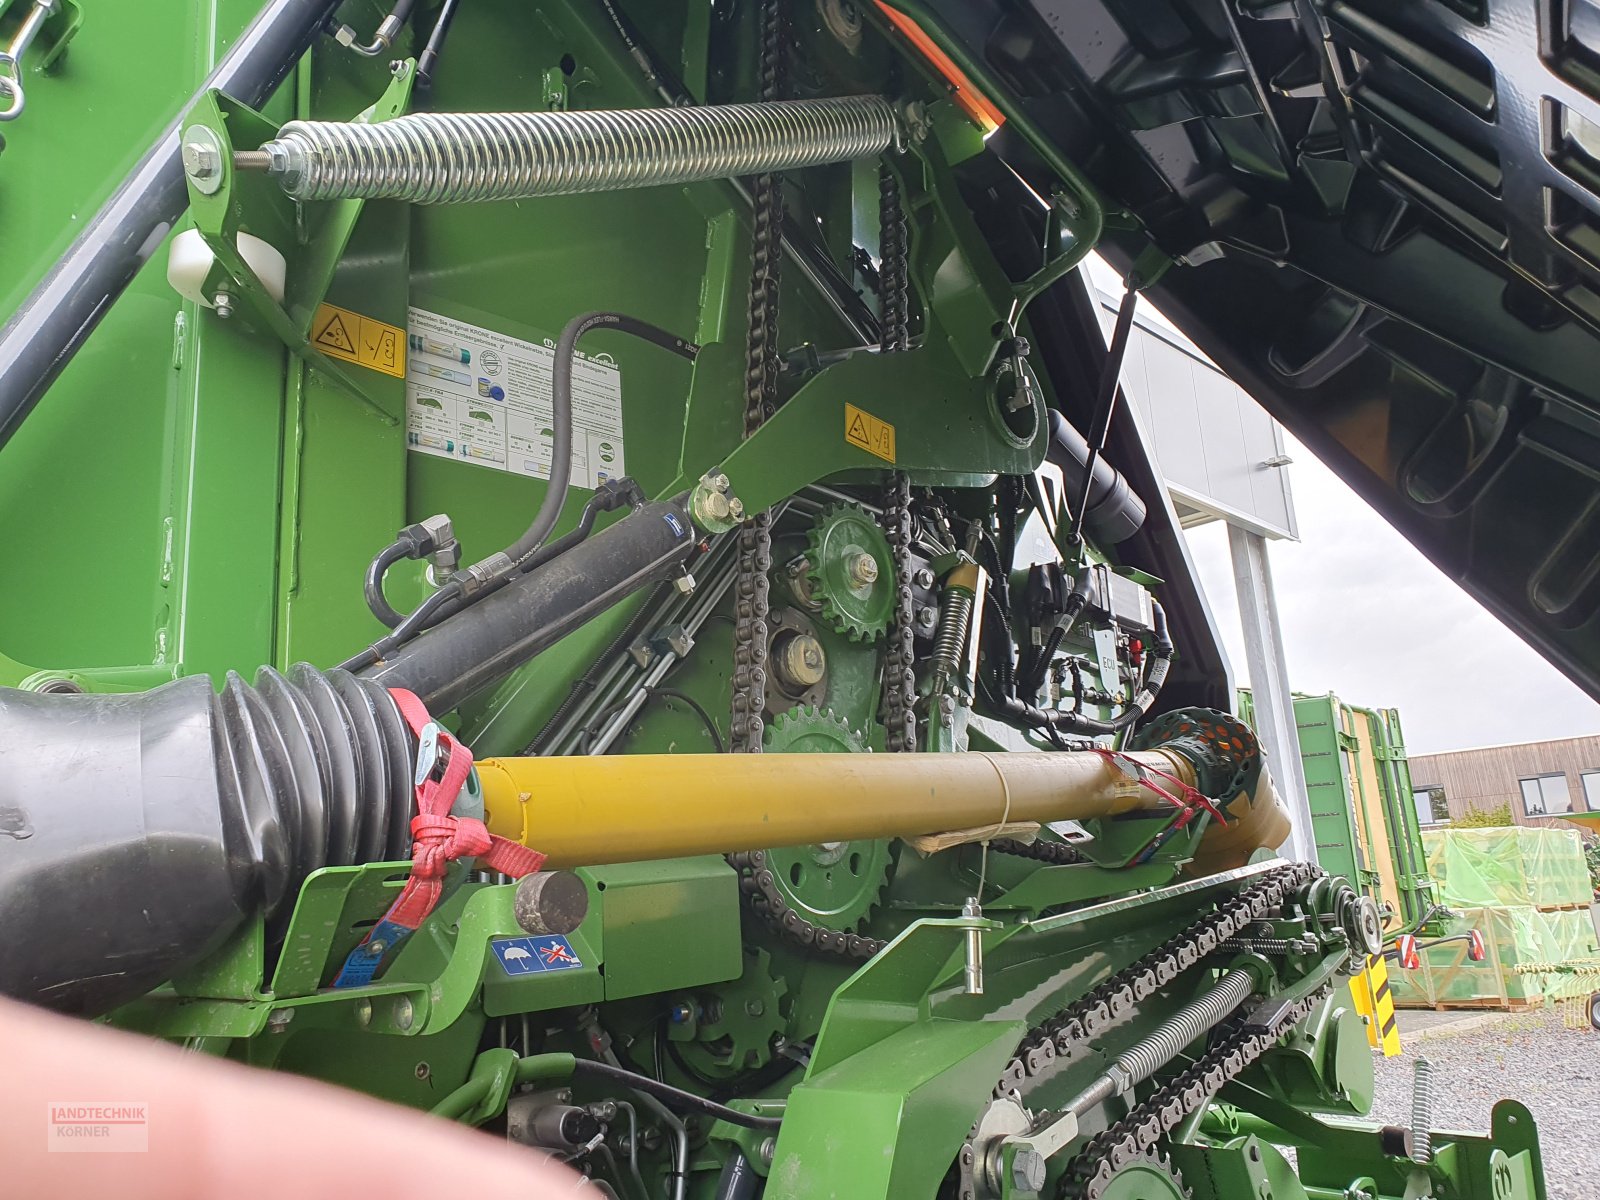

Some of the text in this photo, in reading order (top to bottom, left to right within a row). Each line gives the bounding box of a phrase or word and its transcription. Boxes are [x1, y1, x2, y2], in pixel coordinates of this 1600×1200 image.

[416, 319, 452, 333] bestmögliche
[449, 322, 468, 332] original
[470, 329, 489, 338] KRONE
[491, 335, 512, 344] excellent
[588, 353, 618, 370] excellent
[1102, 656, 1116, 670] ECU
